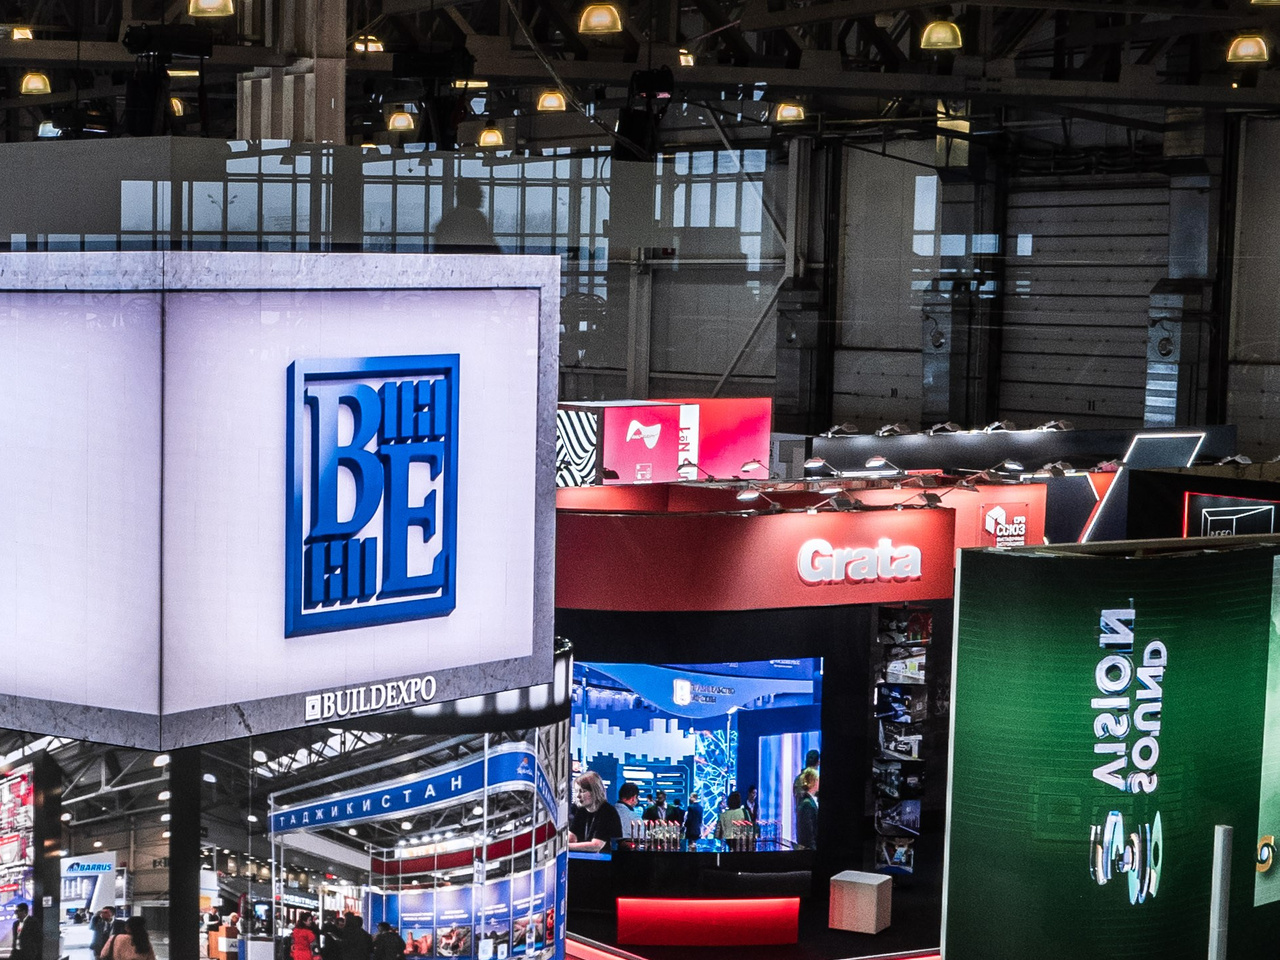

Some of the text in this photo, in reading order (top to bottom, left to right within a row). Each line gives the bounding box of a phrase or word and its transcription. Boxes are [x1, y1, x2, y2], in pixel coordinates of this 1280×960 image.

[797, 537, 923, 585] Grata
[321, 675, 437, 719] BUILDEXPO
[278, 775, 464, 826] ТАДЖИКИСТАН
[79, 863, 112, 872] BARRUS
